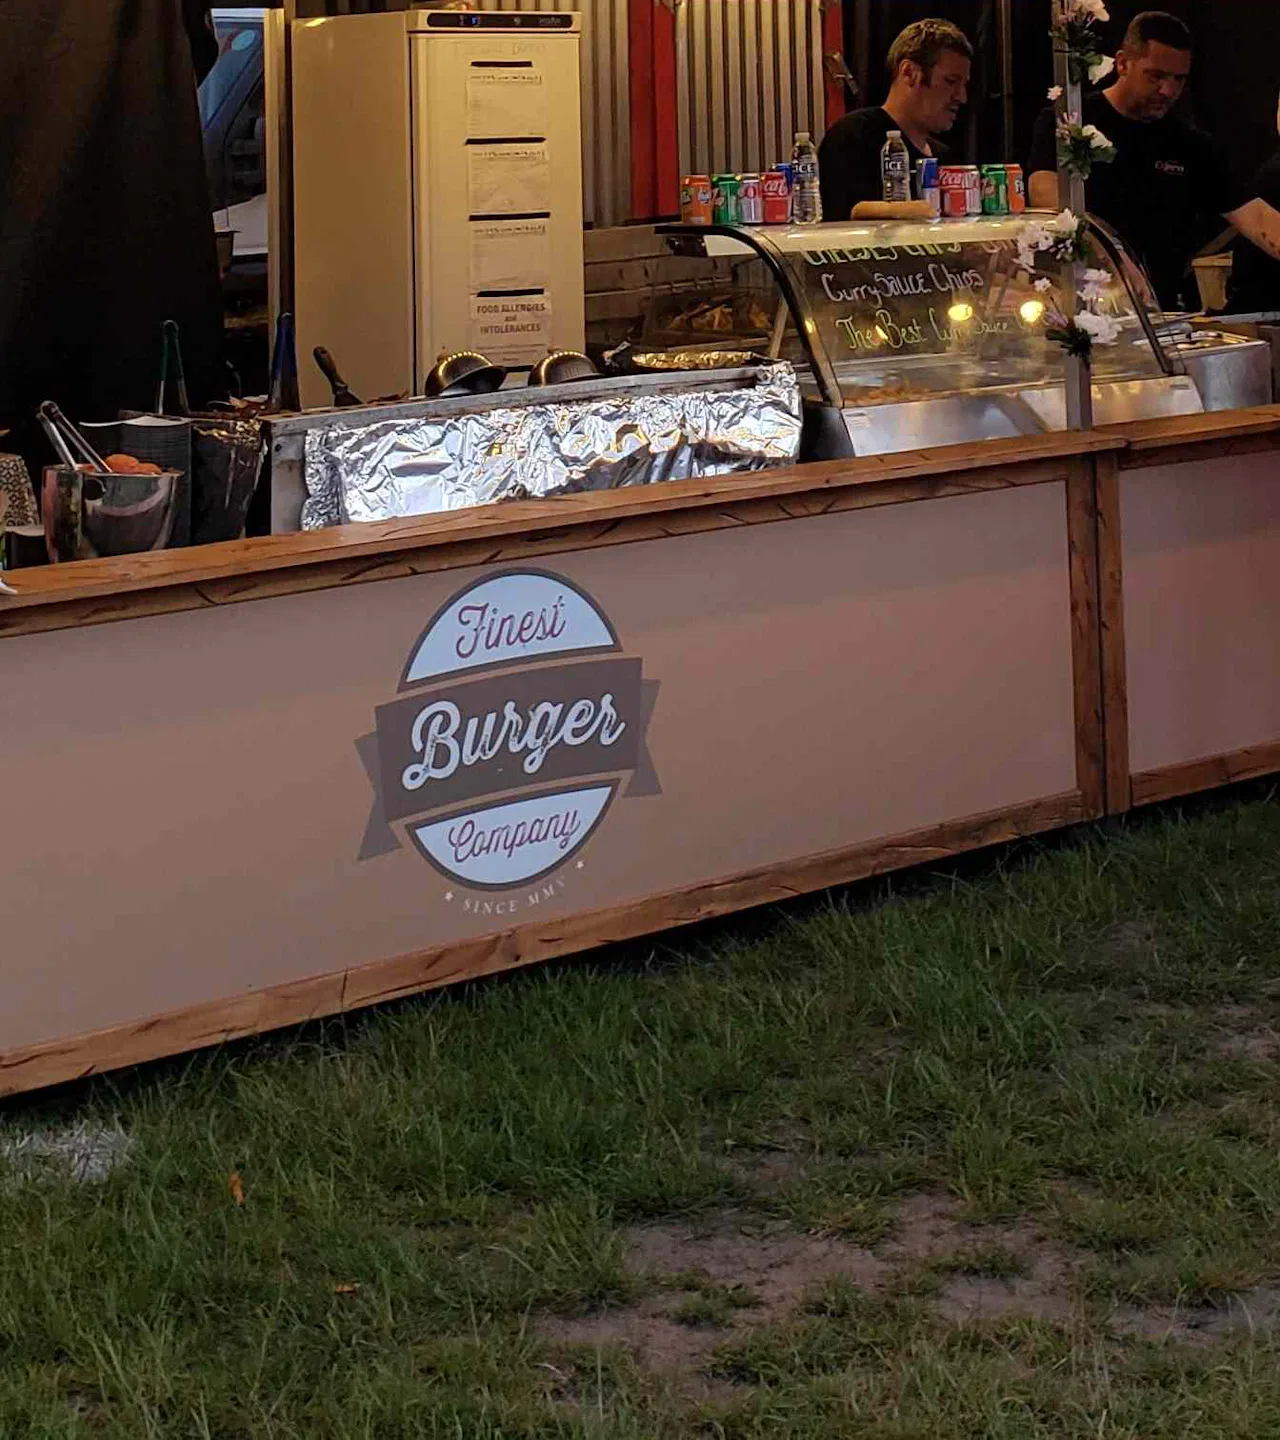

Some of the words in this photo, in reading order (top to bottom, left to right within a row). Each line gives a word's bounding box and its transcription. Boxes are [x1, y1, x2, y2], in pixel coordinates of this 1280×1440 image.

[877, 309, 926, 349] Best
[456, 595, 567, 659] Finest
[401, 693, 626, 791] Burger
[448, 808, 583, 863] Company
[463, 897, 518, 915] SINCE
